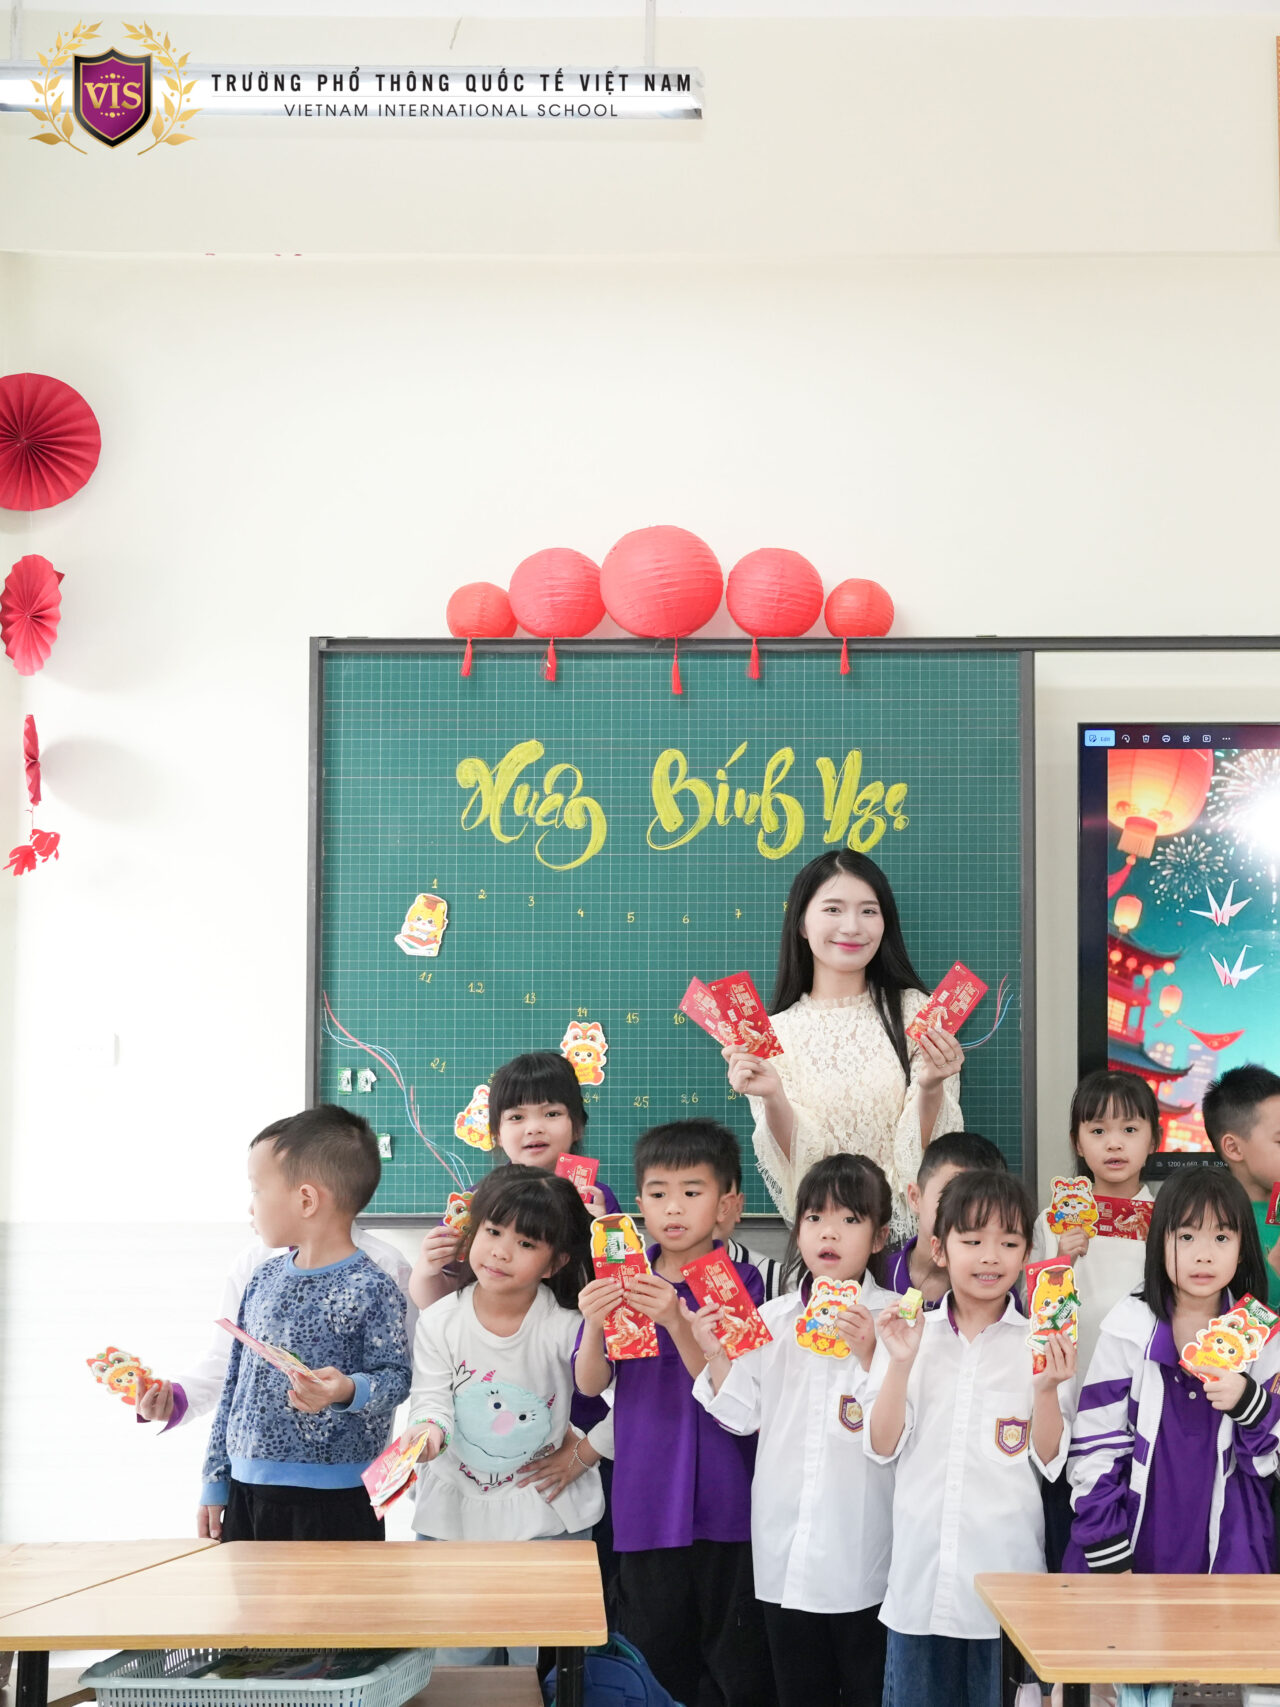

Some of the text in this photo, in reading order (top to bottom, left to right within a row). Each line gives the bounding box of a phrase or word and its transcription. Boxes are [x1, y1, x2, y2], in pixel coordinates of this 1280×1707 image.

[432, 878, 438, 889] 1
[478, 889, 487, 899] 2
[528, 896, 535, 907] 3
[627, 912, 635, 923] 5
[682, 915, 690, 924] 6
[419, 971, 432, 983] 11
[468, 982, 485, 993] 12
[524, 992, 536, 1005] 13
[626, 1013, 640, 1024] 15
[673, 1013, 685, 1025] 16
[430, 1058, 446, 1073] 21
[633, 1096, 649, 1108] 25
